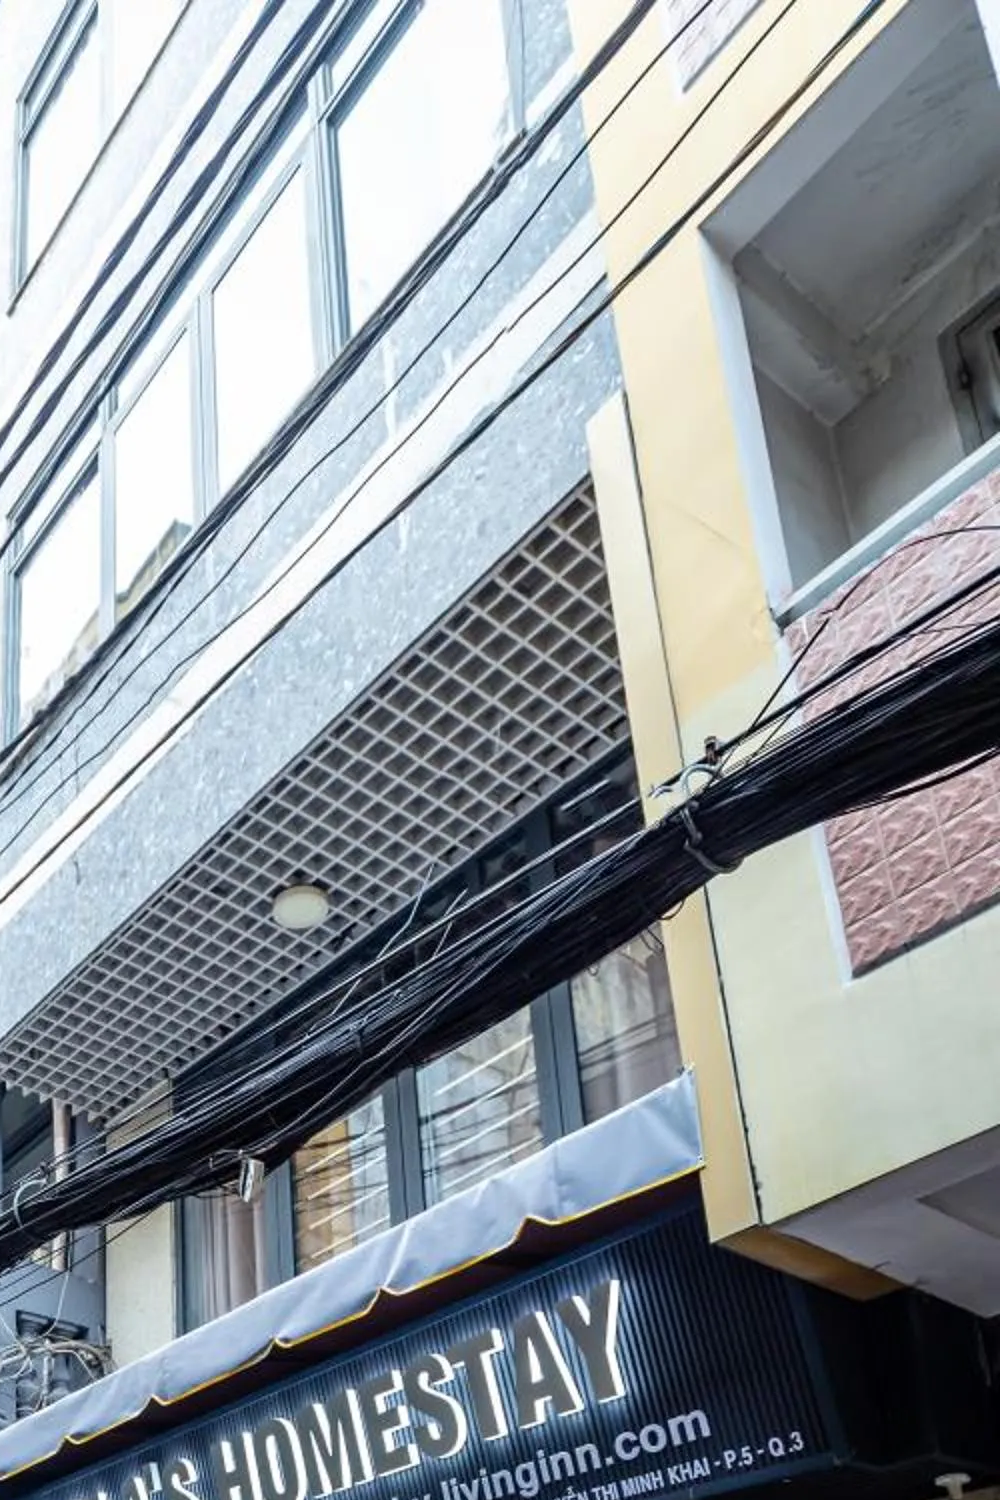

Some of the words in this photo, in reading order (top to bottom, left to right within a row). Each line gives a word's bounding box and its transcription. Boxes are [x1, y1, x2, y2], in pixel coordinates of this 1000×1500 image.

[620, 1469, 664, 1498] MINH
[667, 1457, 711, 1485] KHAI
[723, 1446, 753, 1469] P.5
